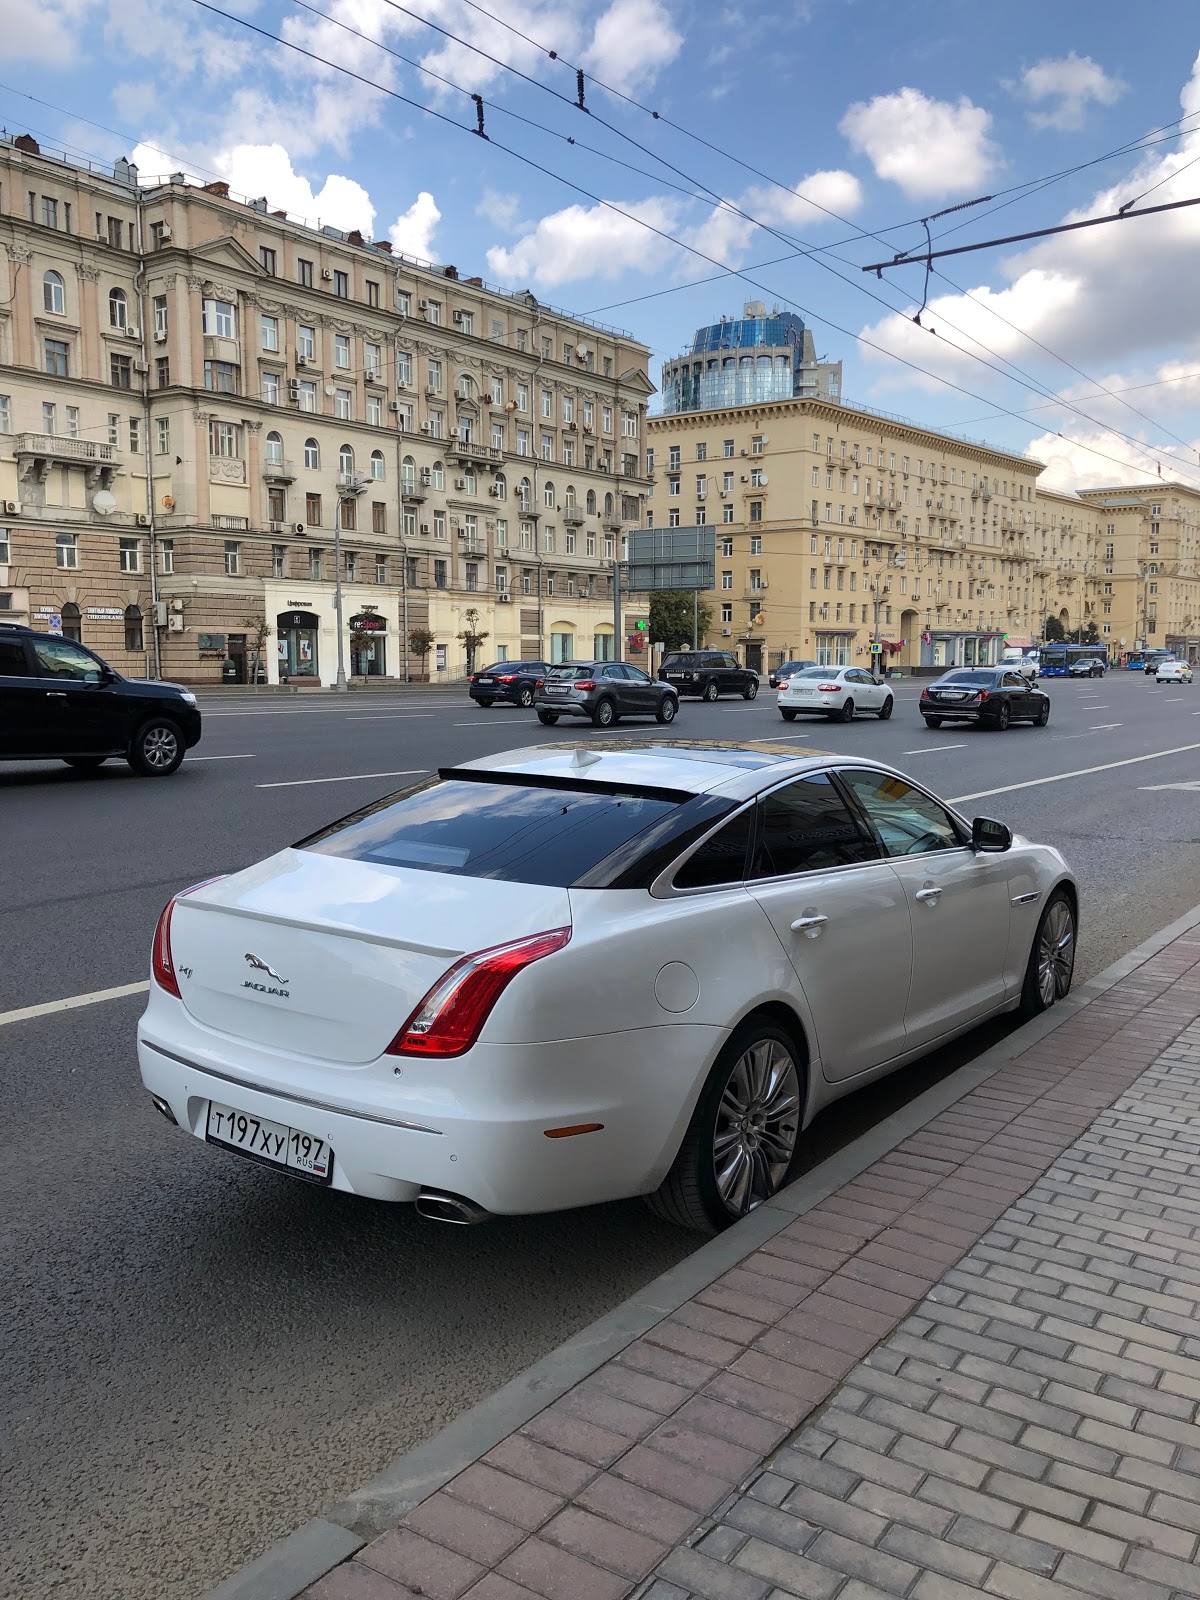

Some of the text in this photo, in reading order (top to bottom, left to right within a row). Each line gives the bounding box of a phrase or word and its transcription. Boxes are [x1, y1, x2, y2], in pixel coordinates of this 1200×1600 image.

[239, 980, 291, 999] JAGUAR
[291, 1132, 324, 1161] 197
[296, 1156, 313, 1169] RUS
